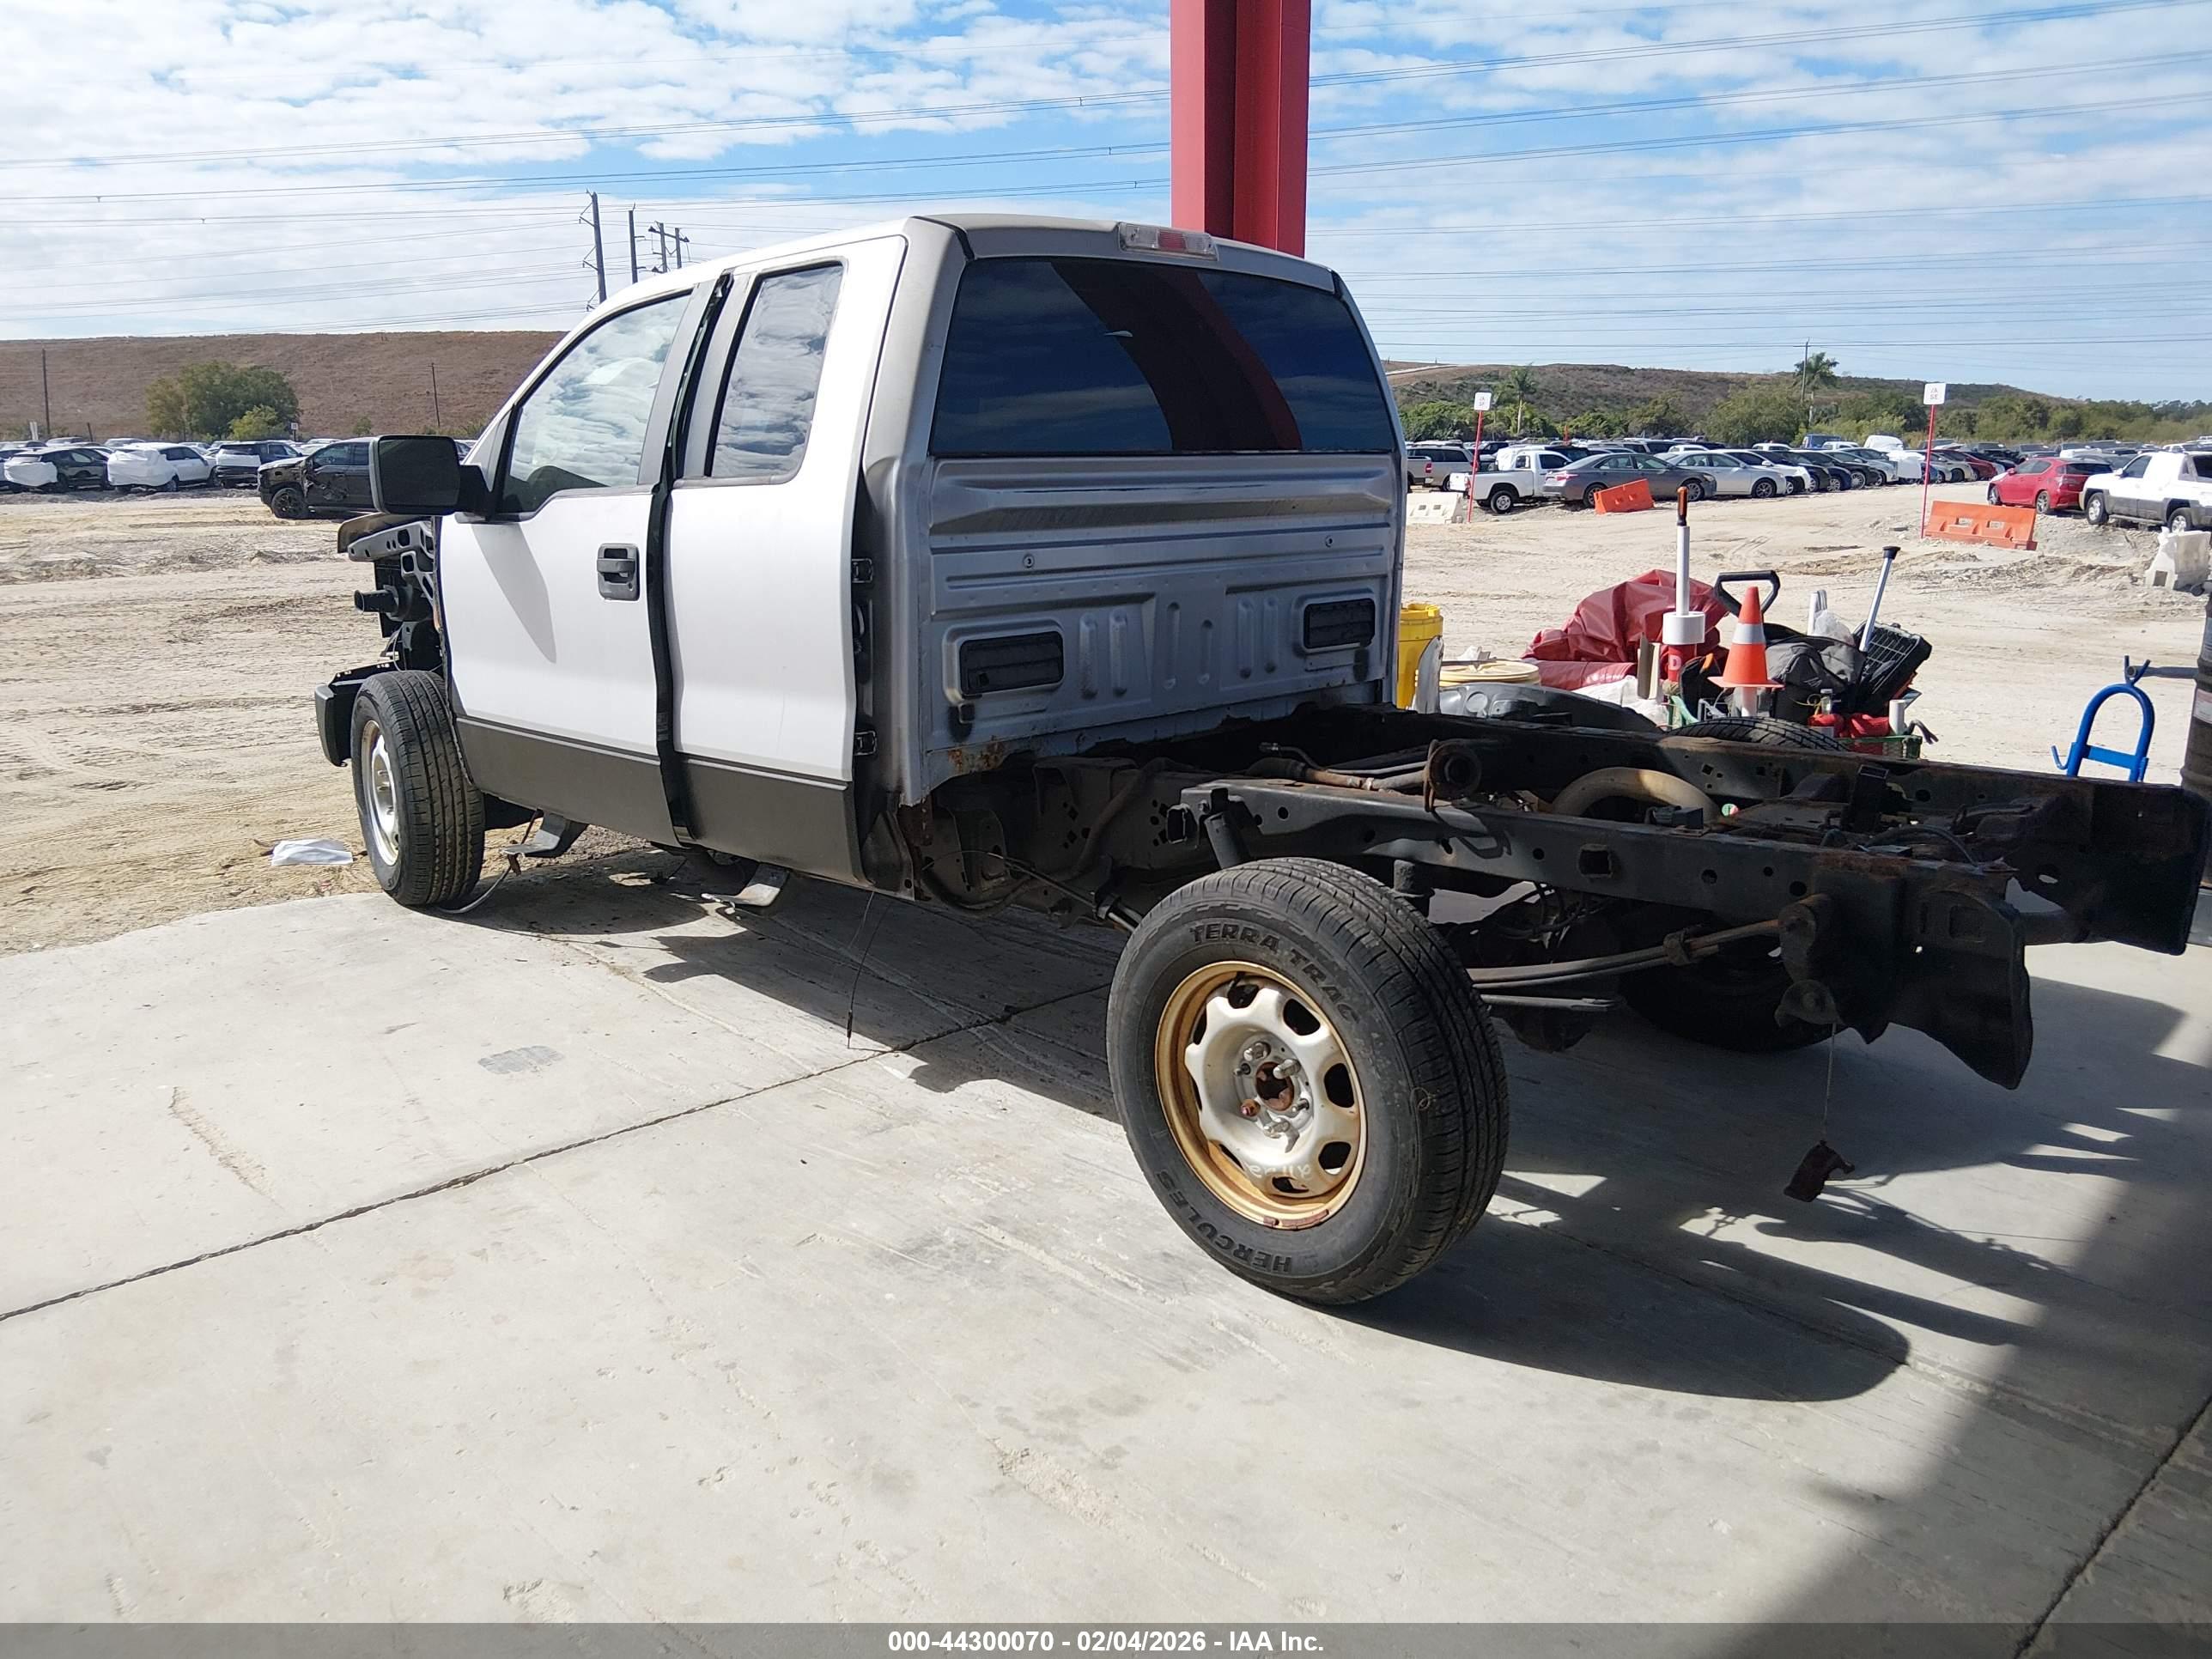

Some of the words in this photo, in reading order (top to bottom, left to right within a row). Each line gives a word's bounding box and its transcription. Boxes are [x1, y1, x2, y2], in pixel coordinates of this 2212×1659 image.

[1190, 923, 1281, 954] TERRA
[1290, 948, 1360, 1024] TRAC
[1157, 1170, 1292, 1273] HERCULES
